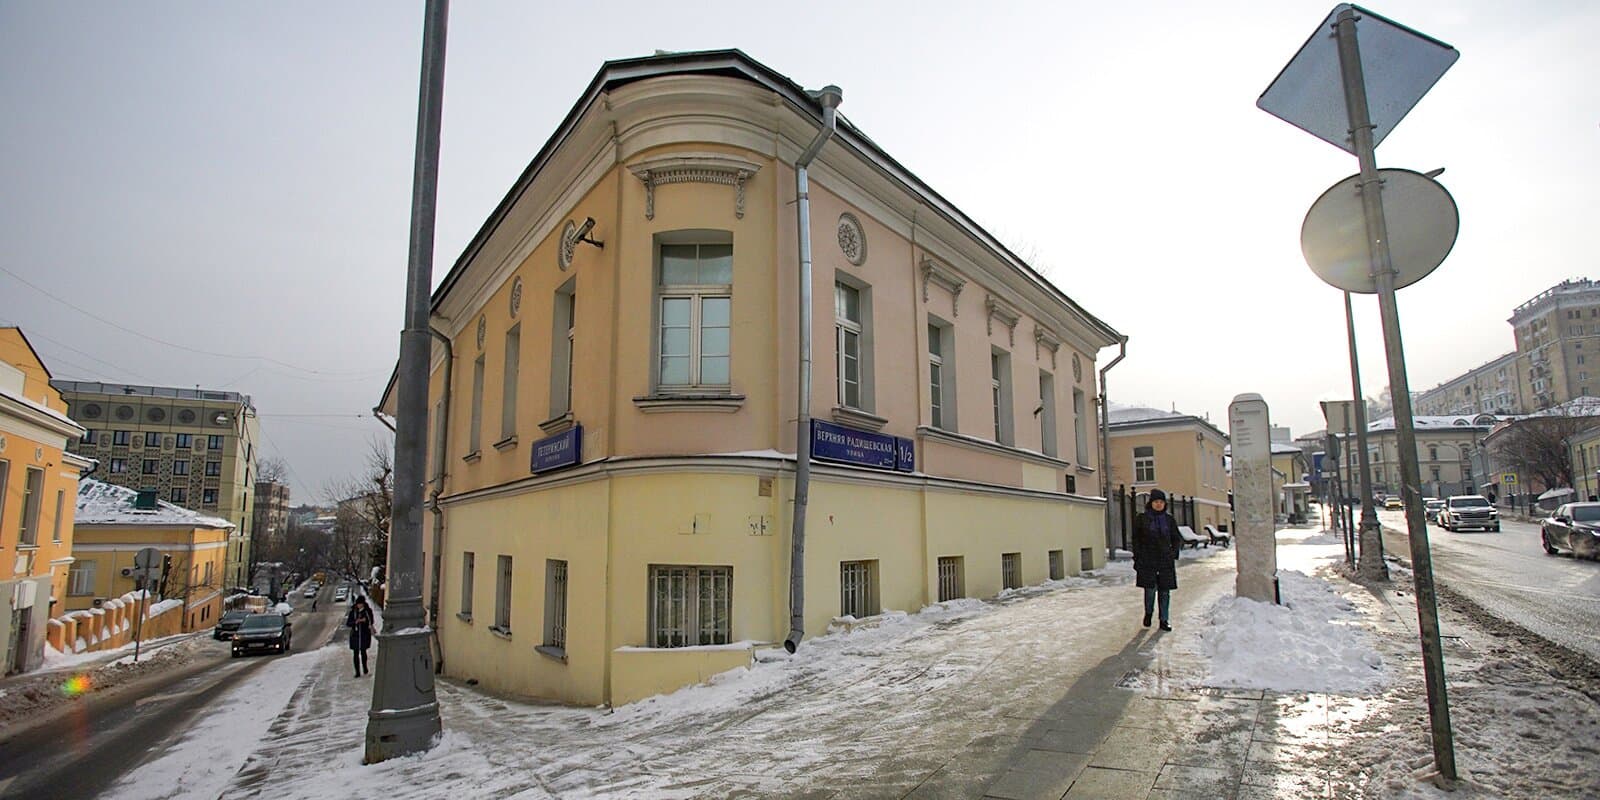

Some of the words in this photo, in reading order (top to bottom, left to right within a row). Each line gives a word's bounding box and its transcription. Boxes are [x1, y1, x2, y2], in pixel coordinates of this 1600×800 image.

[817, 430, 845, 444] ВЕРХНЯЯ
[847, 436, 892, 453] РАДИЩЕВСКАЯ
[900, 446, 912, 464] 1/2
